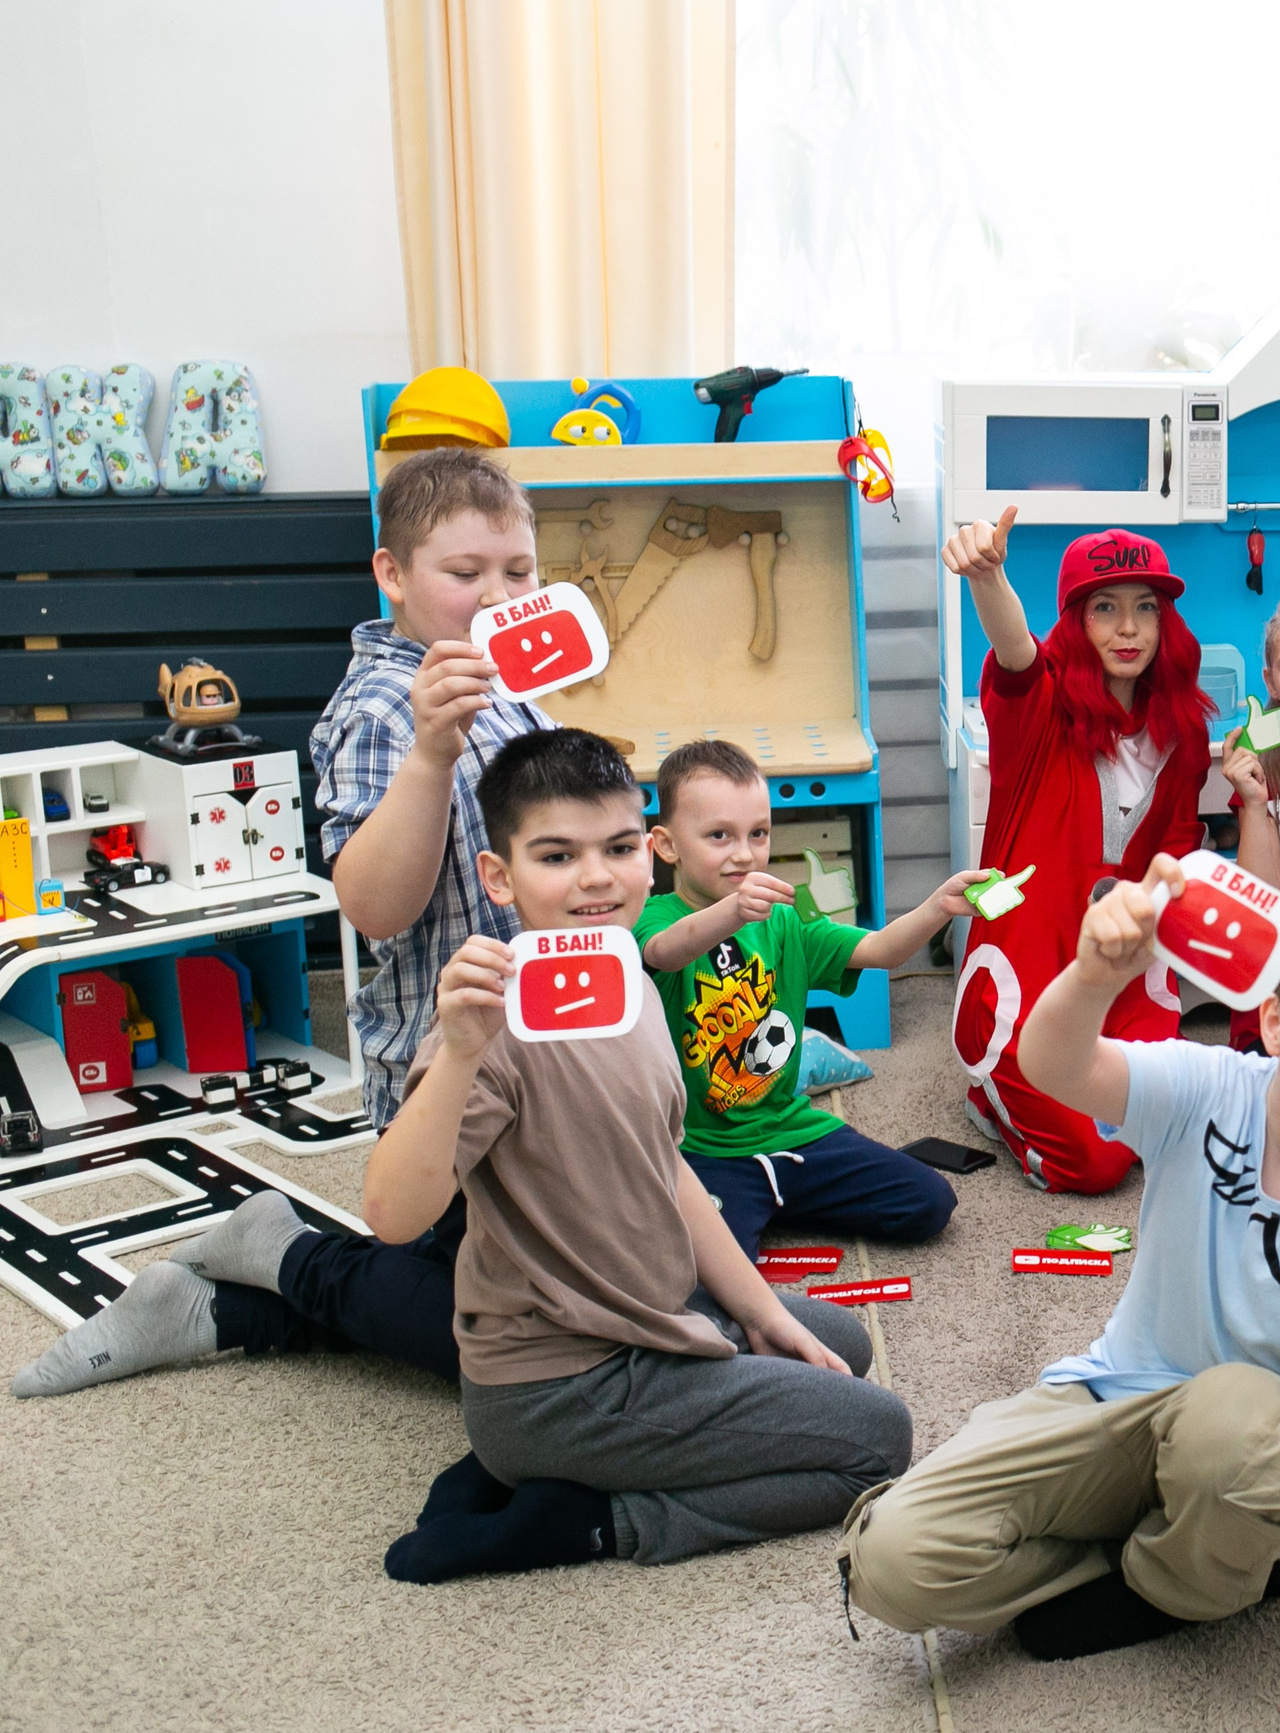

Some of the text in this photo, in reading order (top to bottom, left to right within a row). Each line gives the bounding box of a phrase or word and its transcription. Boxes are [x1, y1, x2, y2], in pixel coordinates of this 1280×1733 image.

[493, 594, 553, 628] В БАН!
[233, 765, 255, 784] 03
[1210, 864, 1278, 913] В БАН!
[538, 932, 603, 954] В БАН!
[1041, 1257, 1111, 1267] ПОДПИСКА
[88, 1351, 112, 1370] NIKE
